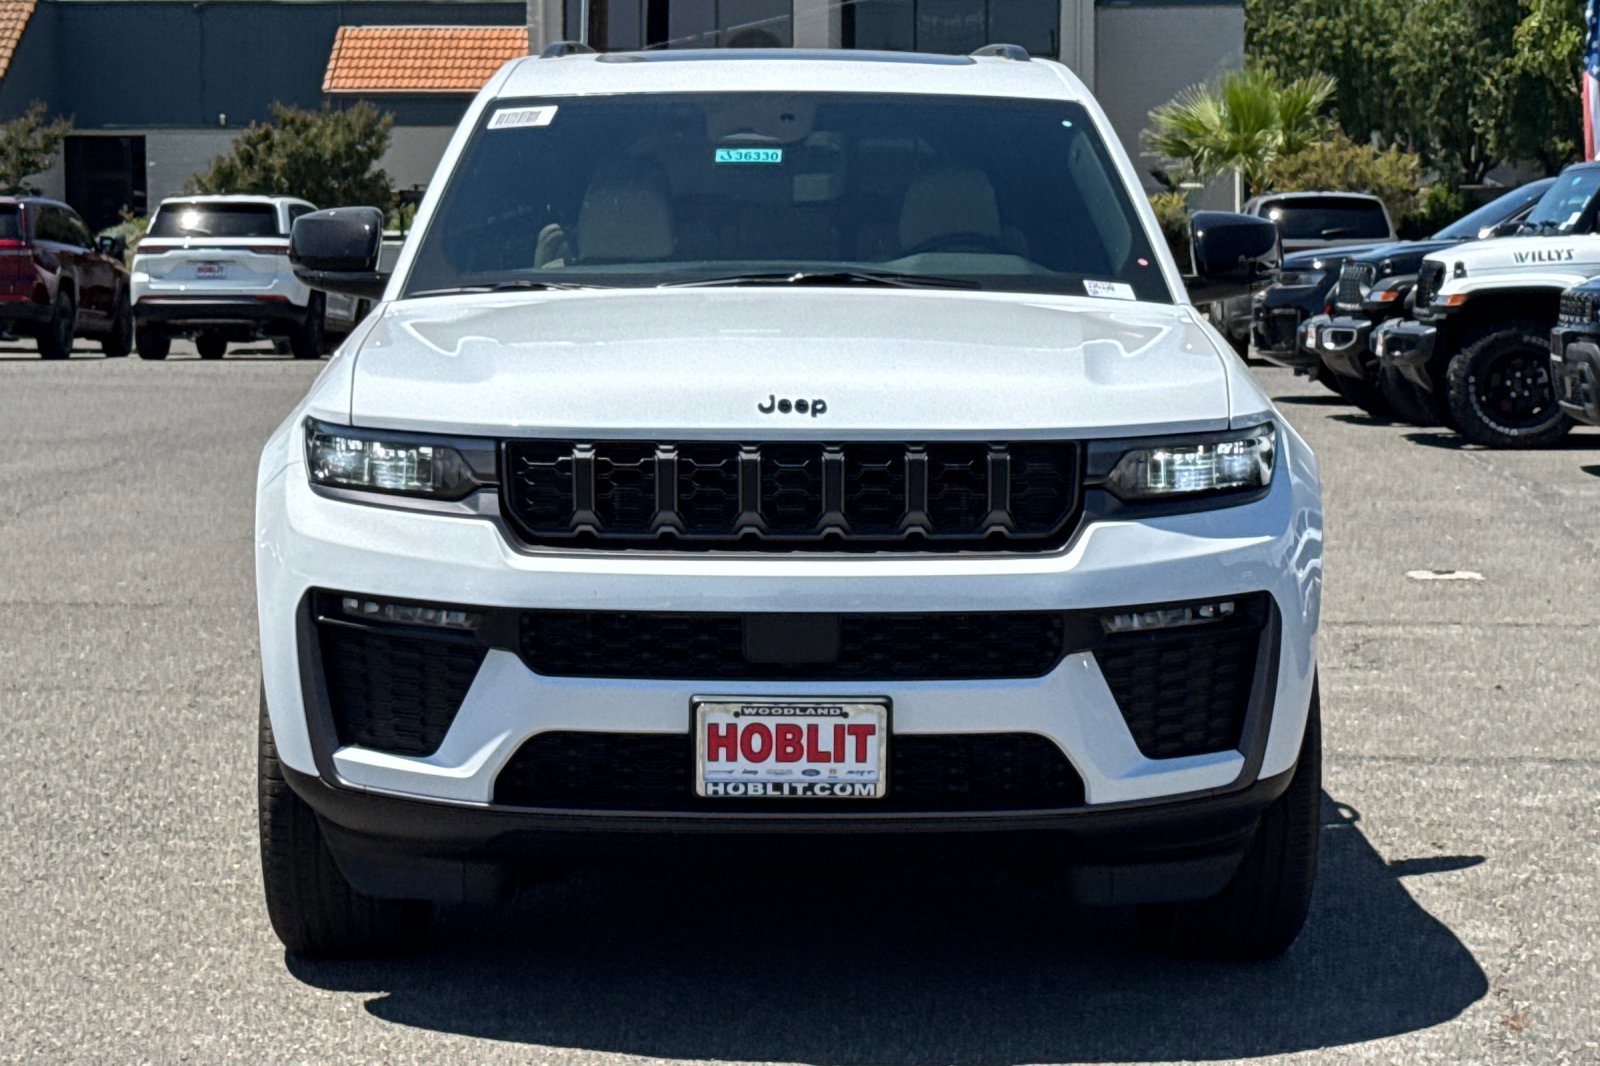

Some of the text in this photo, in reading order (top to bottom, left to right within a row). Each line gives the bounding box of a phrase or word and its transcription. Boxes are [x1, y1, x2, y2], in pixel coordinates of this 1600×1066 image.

[1513, 248, 1574, 263] WILLYS
[757, 394, 827, 418] Jeep
[743, 707, 841, 716] WOODLAND
[707, 722, 876, 764] HOBLIT
[706, 782, 876, 796] HOBLIT.COM
